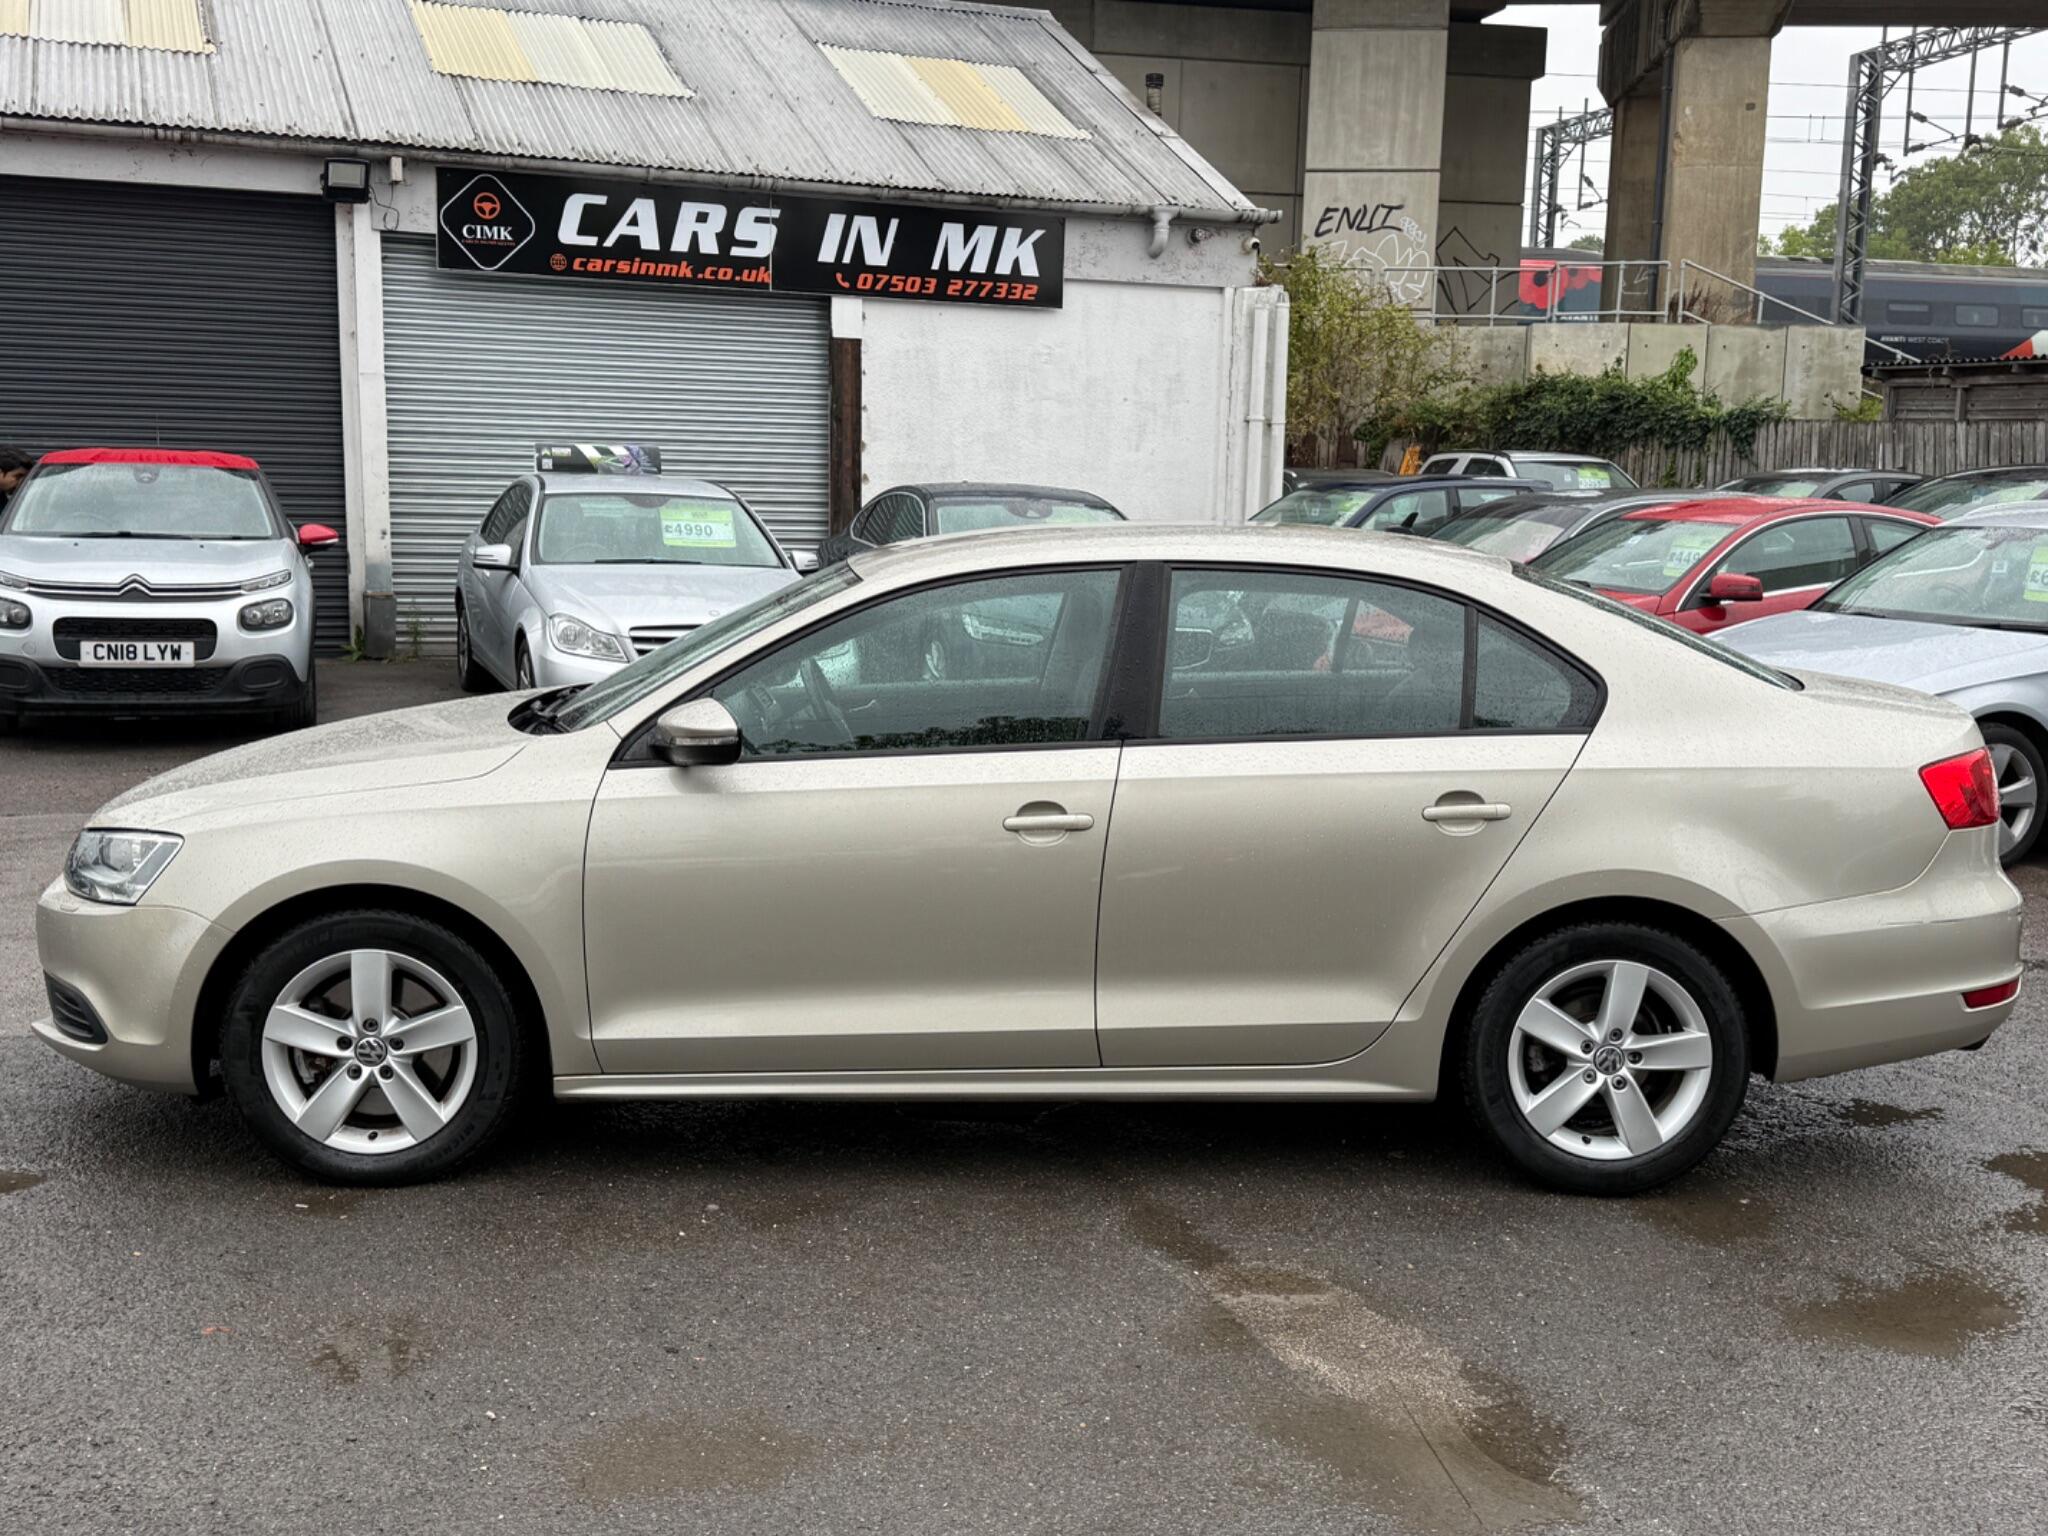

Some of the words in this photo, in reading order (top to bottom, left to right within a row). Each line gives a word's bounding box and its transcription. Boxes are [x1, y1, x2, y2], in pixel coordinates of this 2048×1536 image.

[462, 224, 513, 240] CIMK
[558, 193, 781, 258] CARS
[817, 213, 900, 266] IN
[931, 222, 1046, 277] MK
[572, 257, 772, 284] carsinmk.co.uk
[856, 273, 938, 294] 07503
[946, 279, 1039, 301] 277332
[664, 522, 713, 537] £4990
[93, 643, 137, 661] CN18
[143, 643, 182, 661] LYW
